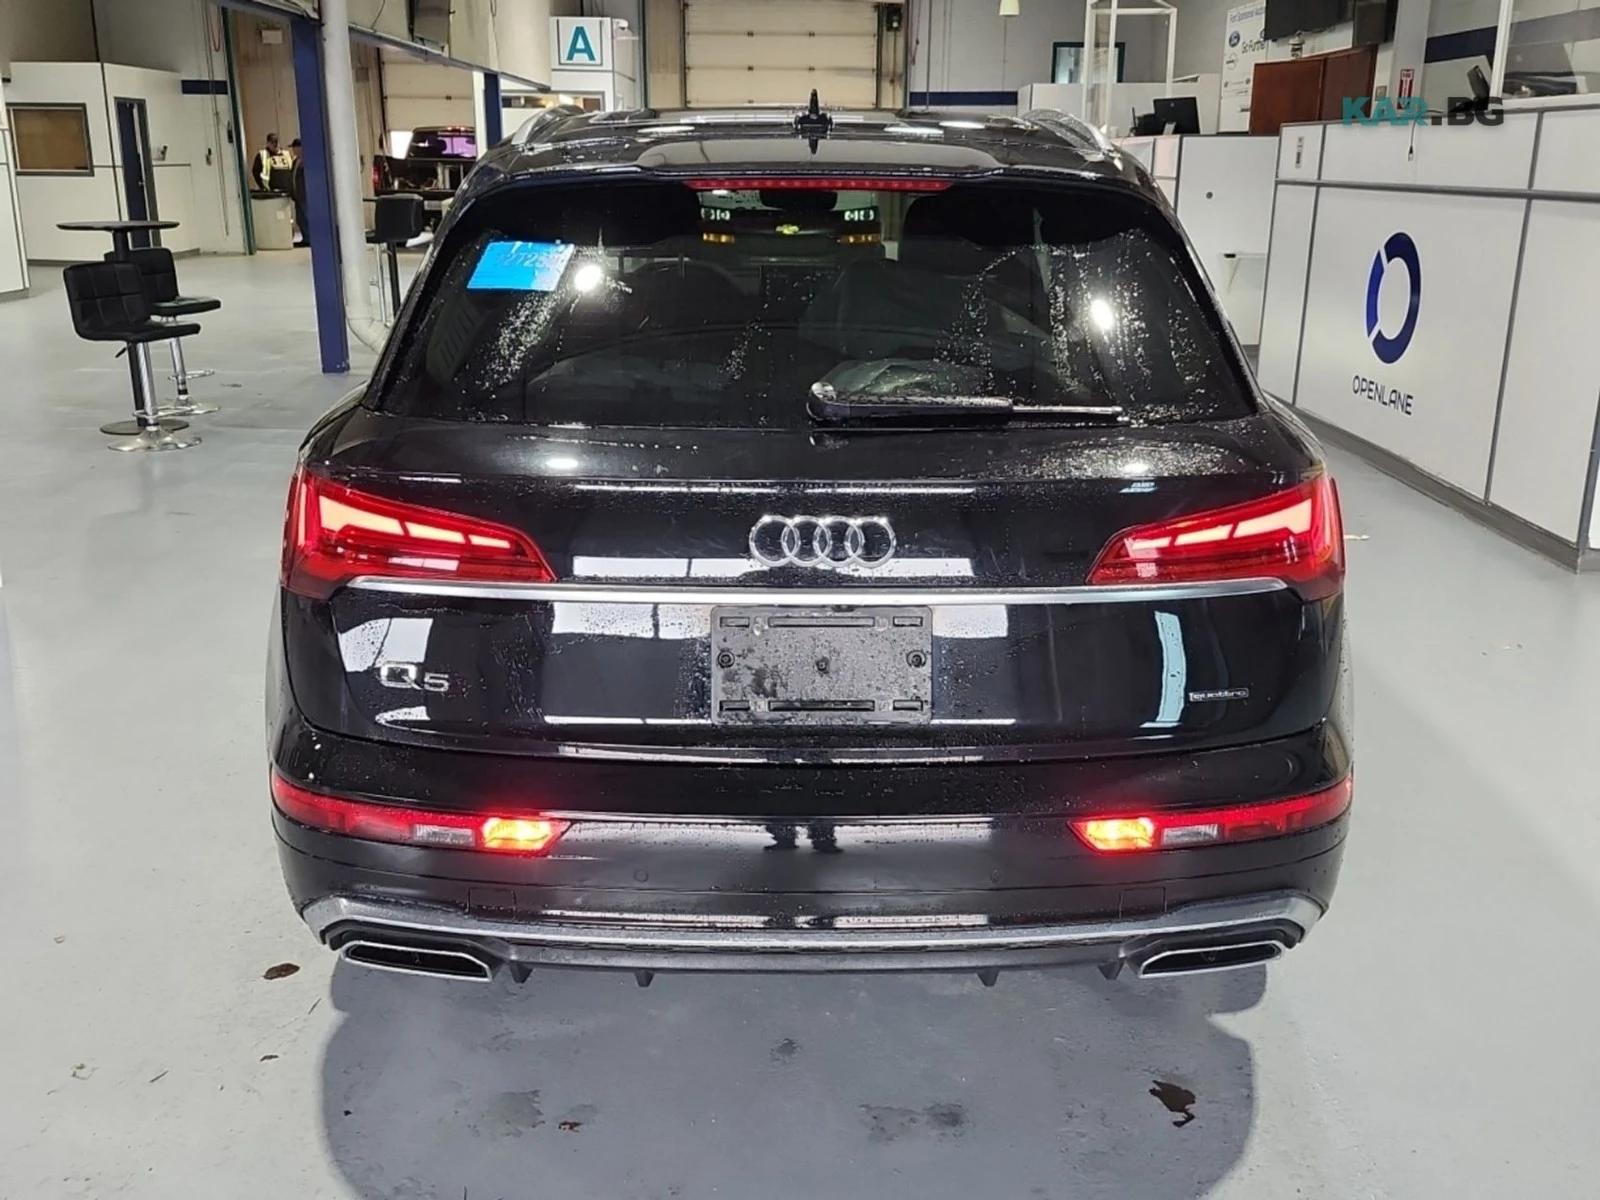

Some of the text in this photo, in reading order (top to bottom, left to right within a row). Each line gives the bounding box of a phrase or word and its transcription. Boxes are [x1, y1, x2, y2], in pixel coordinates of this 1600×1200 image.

[566, 26, 596, 61] A
[1352, 375, 1414, 416] OPENLANE
[380, 662, 450, 692] Q5
